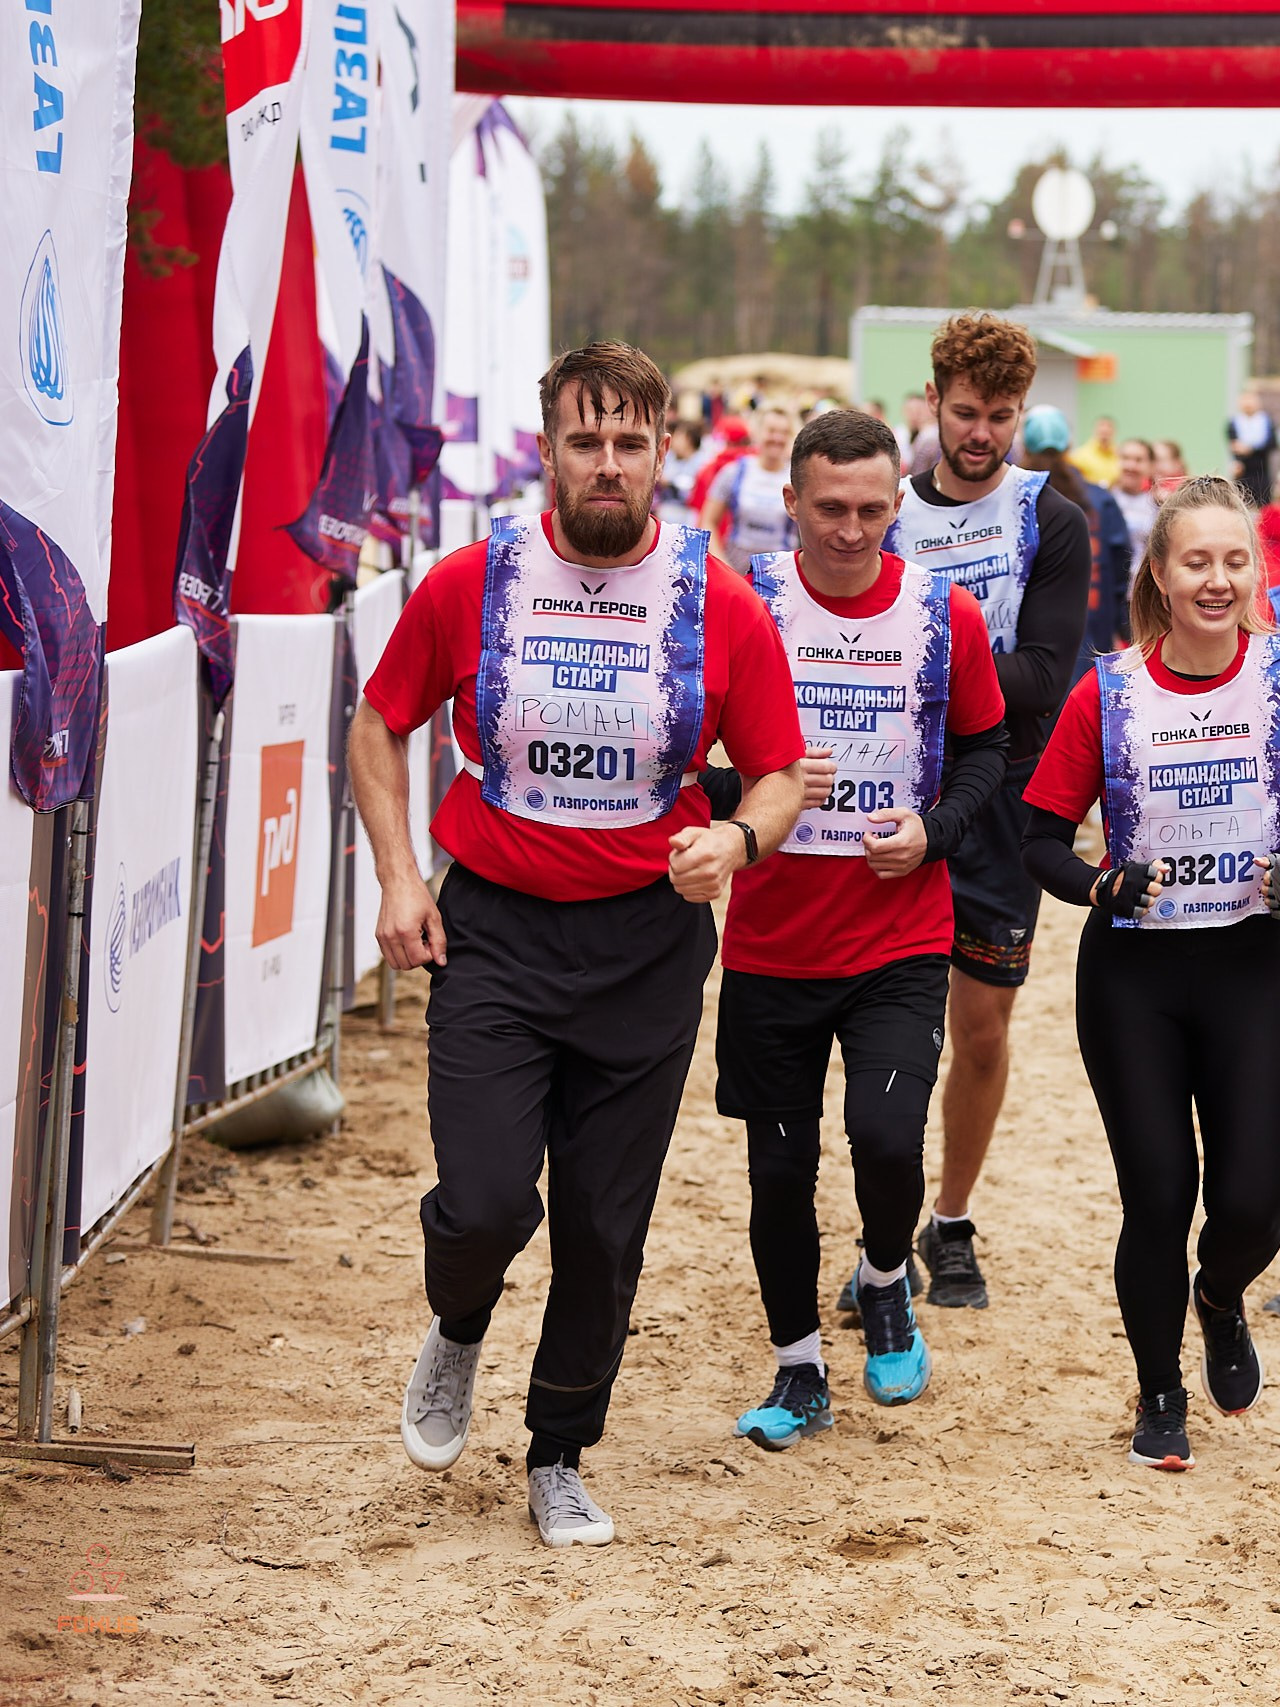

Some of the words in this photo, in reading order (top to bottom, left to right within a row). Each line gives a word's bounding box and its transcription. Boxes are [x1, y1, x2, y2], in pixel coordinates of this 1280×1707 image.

[915, 536, 953, 550] ГОНКА
[957, 526, 1002, 543] ГЕРОЕВ
[936, 554, 1008, 584] АНДНЫЙ
[532, 598, 584, 613] ГОНКА
[589, 600, 647, 618] ГЕРОЕВ
[524, 640, 649, 669] КОМАНДНЫЙ
[797, 646, 844, 660] ГОНКА
[849, 649, 902, 662] ГЕРОЕВ
[556, 667, 616, 690] СТАРТ
[796, 685, 904, 710] КОМАНДНЫЙ
[521, 699, 636, 736] РОМАН
[823, 709, 874, 730] СТАРТ
[1152, 728, 1197, 742] ГОНКА
[1202, 723, 1250, 738] ГЕРОЕВ
[528, 740, 636, 781] 03201
[1151, 757, 1257, 788] КОМАНДНЫЙ
[553, 796, 639, 811] ГАЗПРОМБАНК
[1181, 785, 1231, 808] СТАРТ
[1159, 816, 1240, 843] ОЛЬГА
[1160, 851, 1255, 887] 03202
[1183, 896, 1251, 914] ГАЗПРОМБАНК
